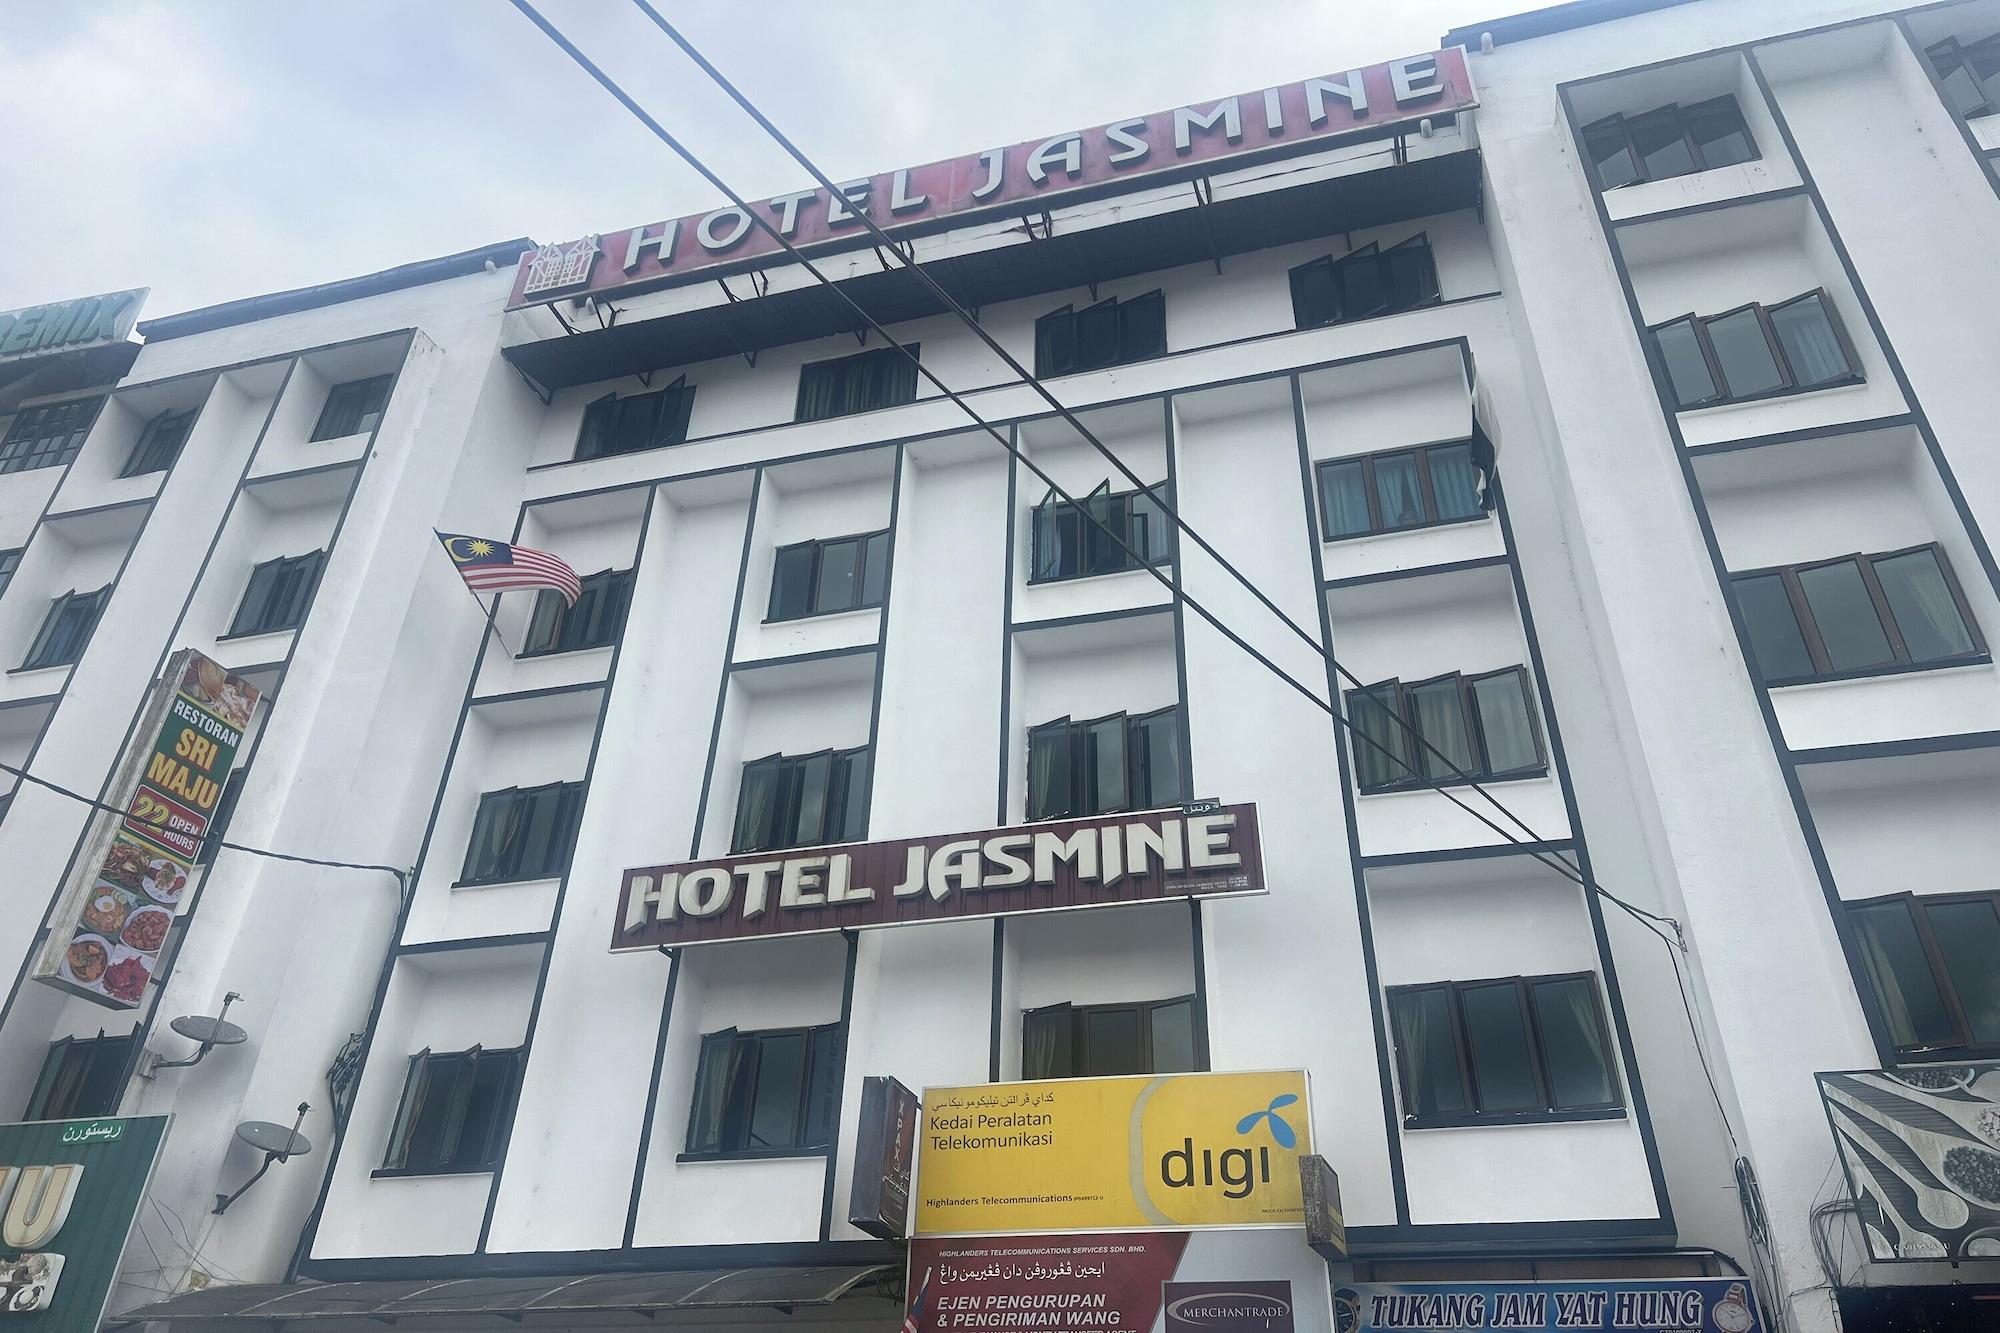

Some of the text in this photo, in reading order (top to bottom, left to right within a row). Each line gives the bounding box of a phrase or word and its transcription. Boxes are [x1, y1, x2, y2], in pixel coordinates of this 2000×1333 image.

[623, 54, 1445, 274] HOTEL JASMINE
[173, 699, 240, 748] RESTORAN
[175, 727, 218, 772] SRI
[146, 751, 219, 811] MAJU
[135, 793, 170, 835] 22
[168, 814, 199, 837] OPEN
[163, 829, 195, 851] HOURS
[623, 813, 1242, 935] HOTEL JASMINE
[62, 1122, 121, 1141] ريستورن
[930, 1112, 1052, 1130] Kedai Peralatan
[931, 1131, 1053, 1150] Telekomunikasi
[1161, 1137, 1270, 1199] digi
[0, 1164, 84, 1250] U
[926, 1197, 979, 1208] Highlanders
[981, 1194, 1073, 1205] Telecommunications
[939, 1249, 989, 1258] HIGHLANDERS
[990, 1247, 1071, 1257] TELECOMMUNICATIONS
[1072, 1246, 1108, 1254] SERVICES
[1128, 1245, 1147, 1253] BHD.
[1002, 1264, 1023, 1279] دان
[937, 1294, 1106, 1310] EJEN PENGURUPAN
[1183, 1306, 1284, 1318] MERCHANTRADE
[1370, 1290, 1703, 1328] TUKANG JAM YAT HUNG
[936, 1311, 1121, 1327] & PENGIRIMAN WANG
